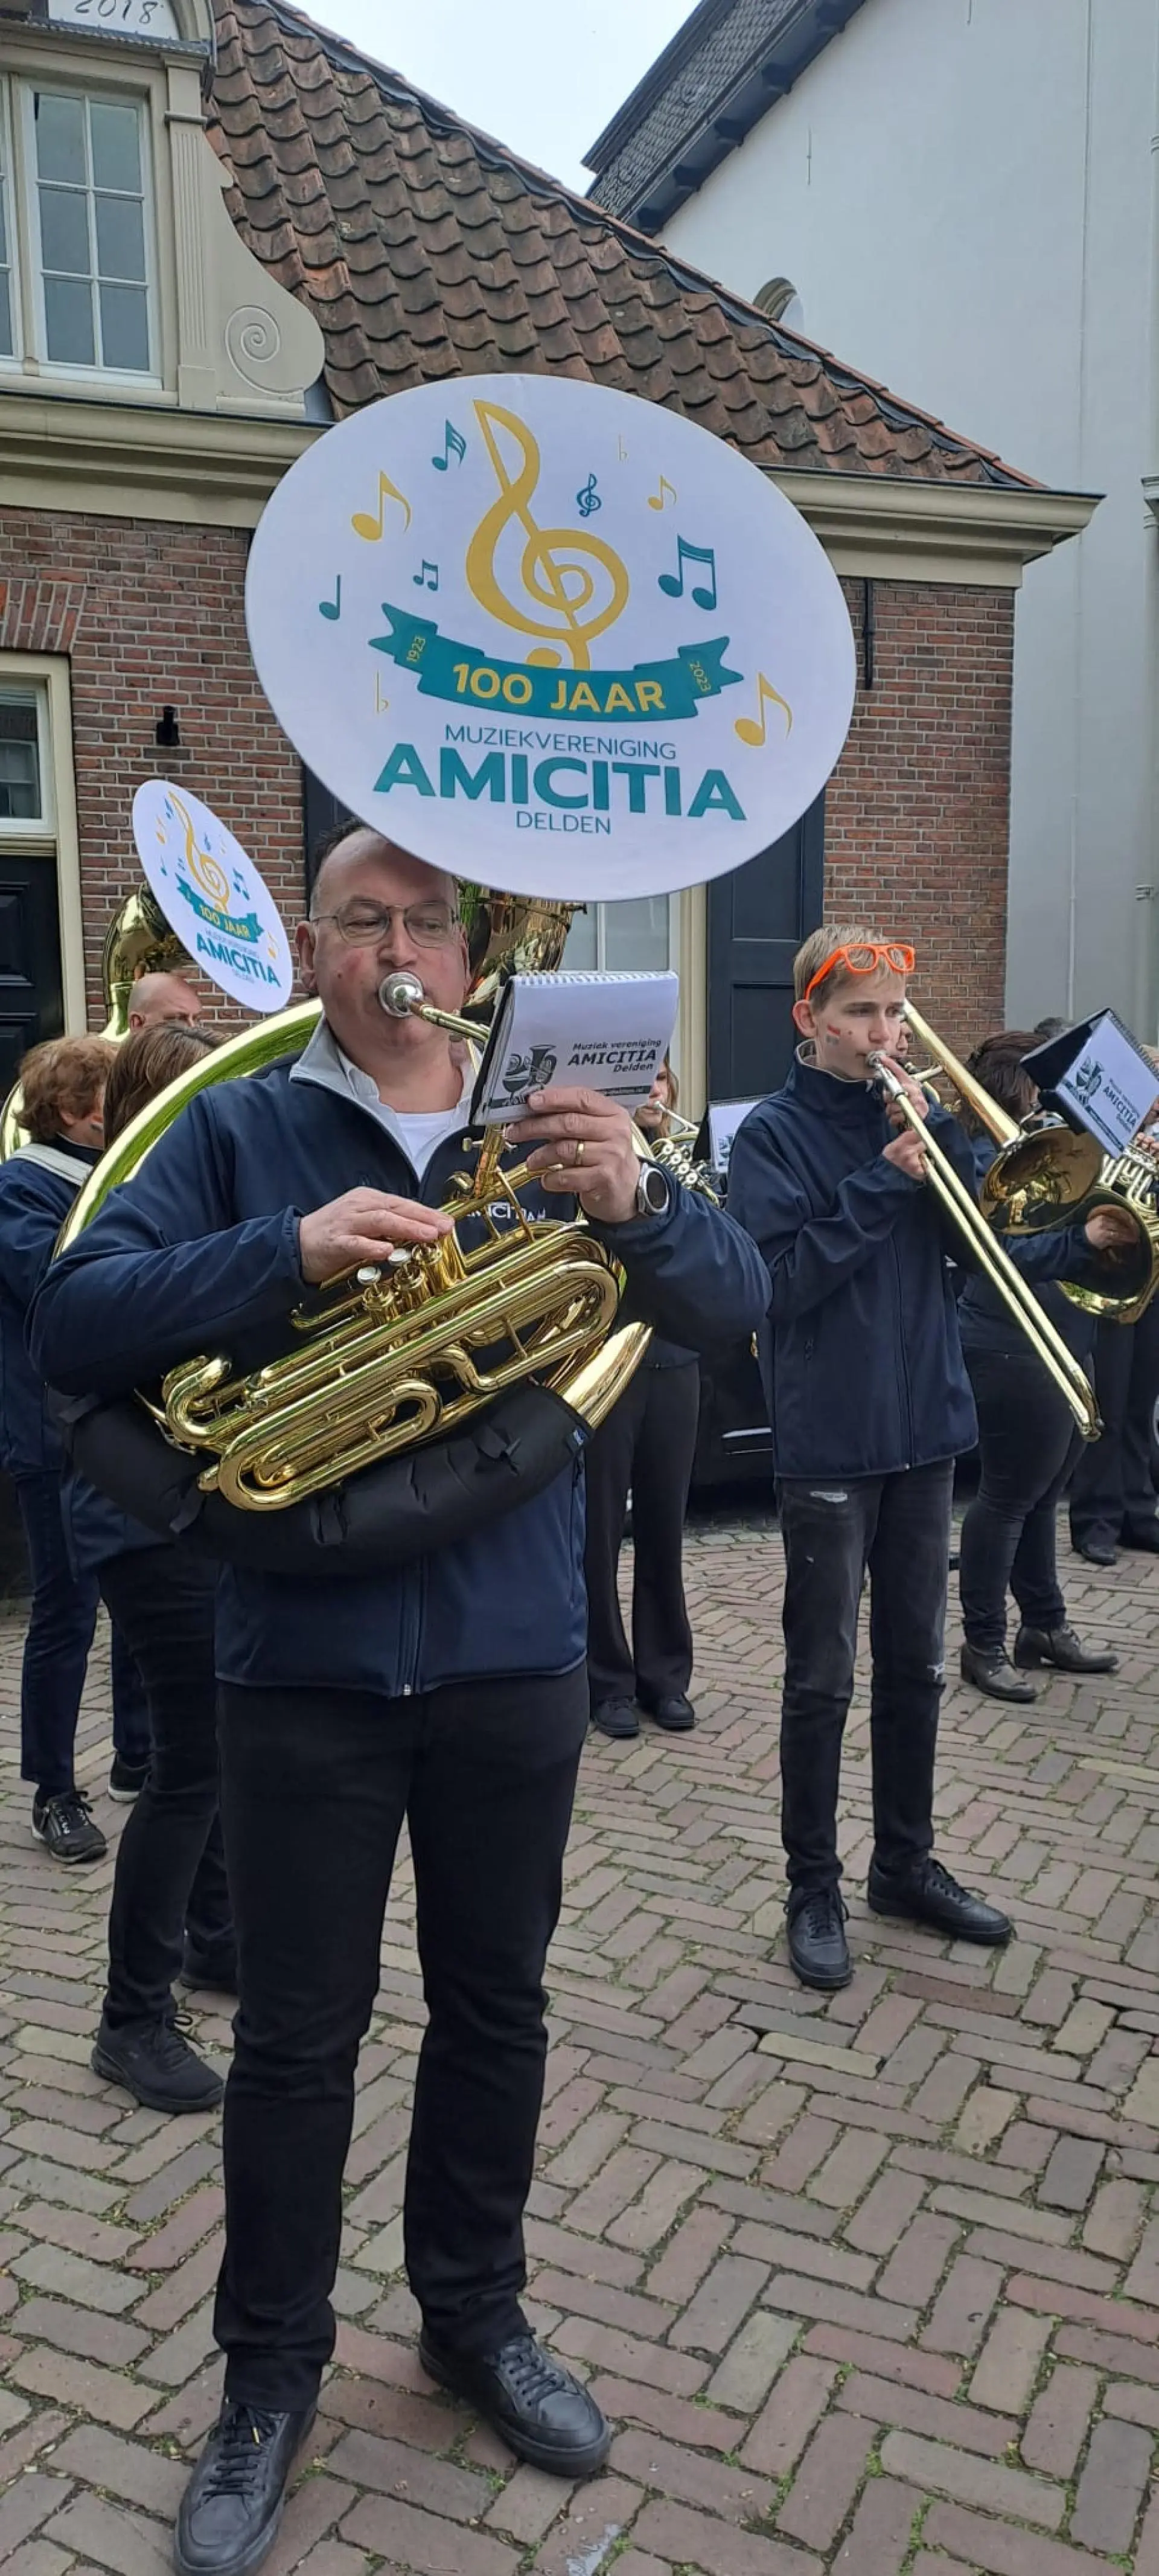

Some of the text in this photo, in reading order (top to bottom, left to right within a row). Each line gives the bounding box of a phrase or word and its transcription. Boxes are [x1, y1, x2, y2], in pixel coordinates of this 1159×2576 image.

[406, 636, 426, 662] 1923
[453, 664, 665, 713] 100 JAAR
[689, 662, 712, 692] 2023
[445, 723, 676, 760] MUZIEKVERENIGING
[373, 743, 747, 821] AMICITIA
[516, 810, 610, 835] DELDEN
[200, 904, 251, 938] 100 JAAR
[197, 932, 281, 988] AMICITIA
[567, 1049, 656, 1066] AMICITIA
[613, 1063, 654, 1072] Delden
